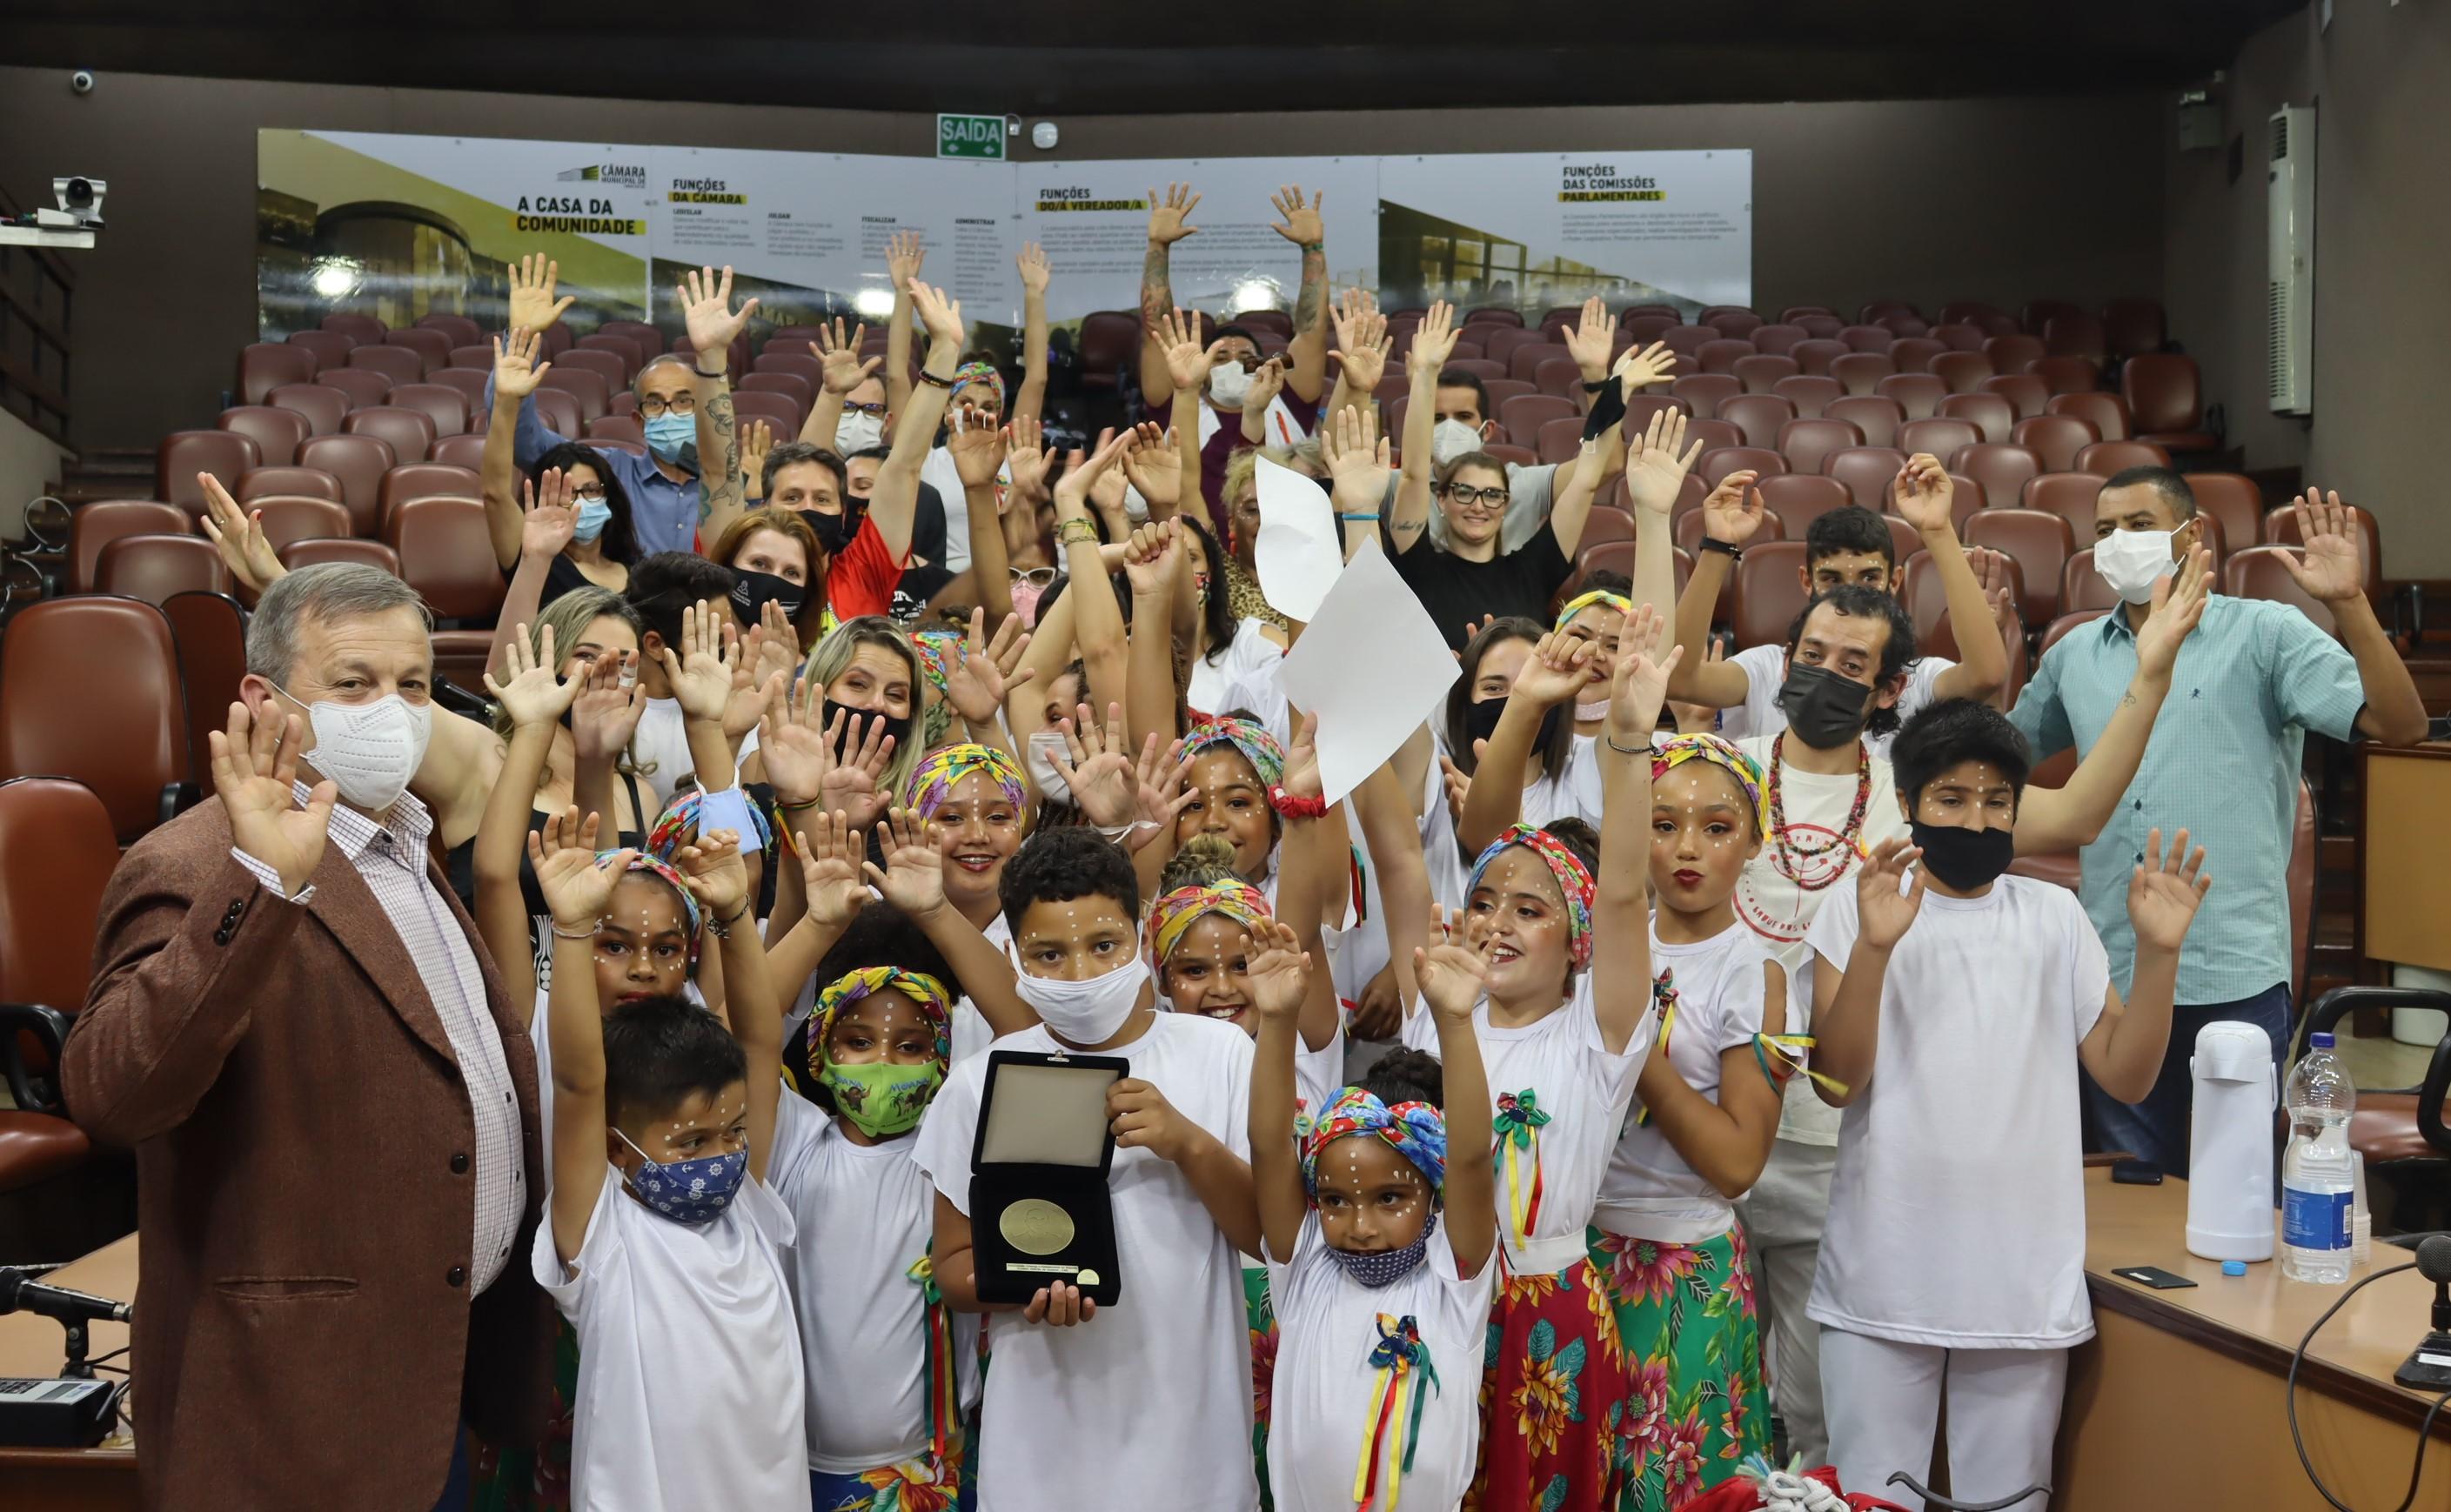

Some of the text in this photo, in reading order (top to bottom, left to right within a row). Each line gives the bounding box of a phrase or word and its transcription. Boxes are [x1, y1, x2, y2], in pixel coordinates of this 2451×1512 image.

[942, 117, 1001, 143] SAÍDA
[600, 162, 646, 177] CÂMARA
[1563, 164, 1616, 178] FUNÇÕES
[600, 175, 635, 184] MUNICIPAL
[673, 178, 727, 192] FUNÇÕES
[1563, 176, 1656, 190] DAS COMISSÕES
[673, 191, 743, 204] DA CÂMARA
[1040, 185, 1090, 200] FUNÇÕES
[1563, 191, 1661, 202] PARLAMENTARES
[518, 196, 613, 215] A CASA DA
[1071, 199, 1143, 211] VEREADOR/A
[516, 216, 635, 235] COMUNIDADE
[889, 1077, 932, 1092] MOANA
